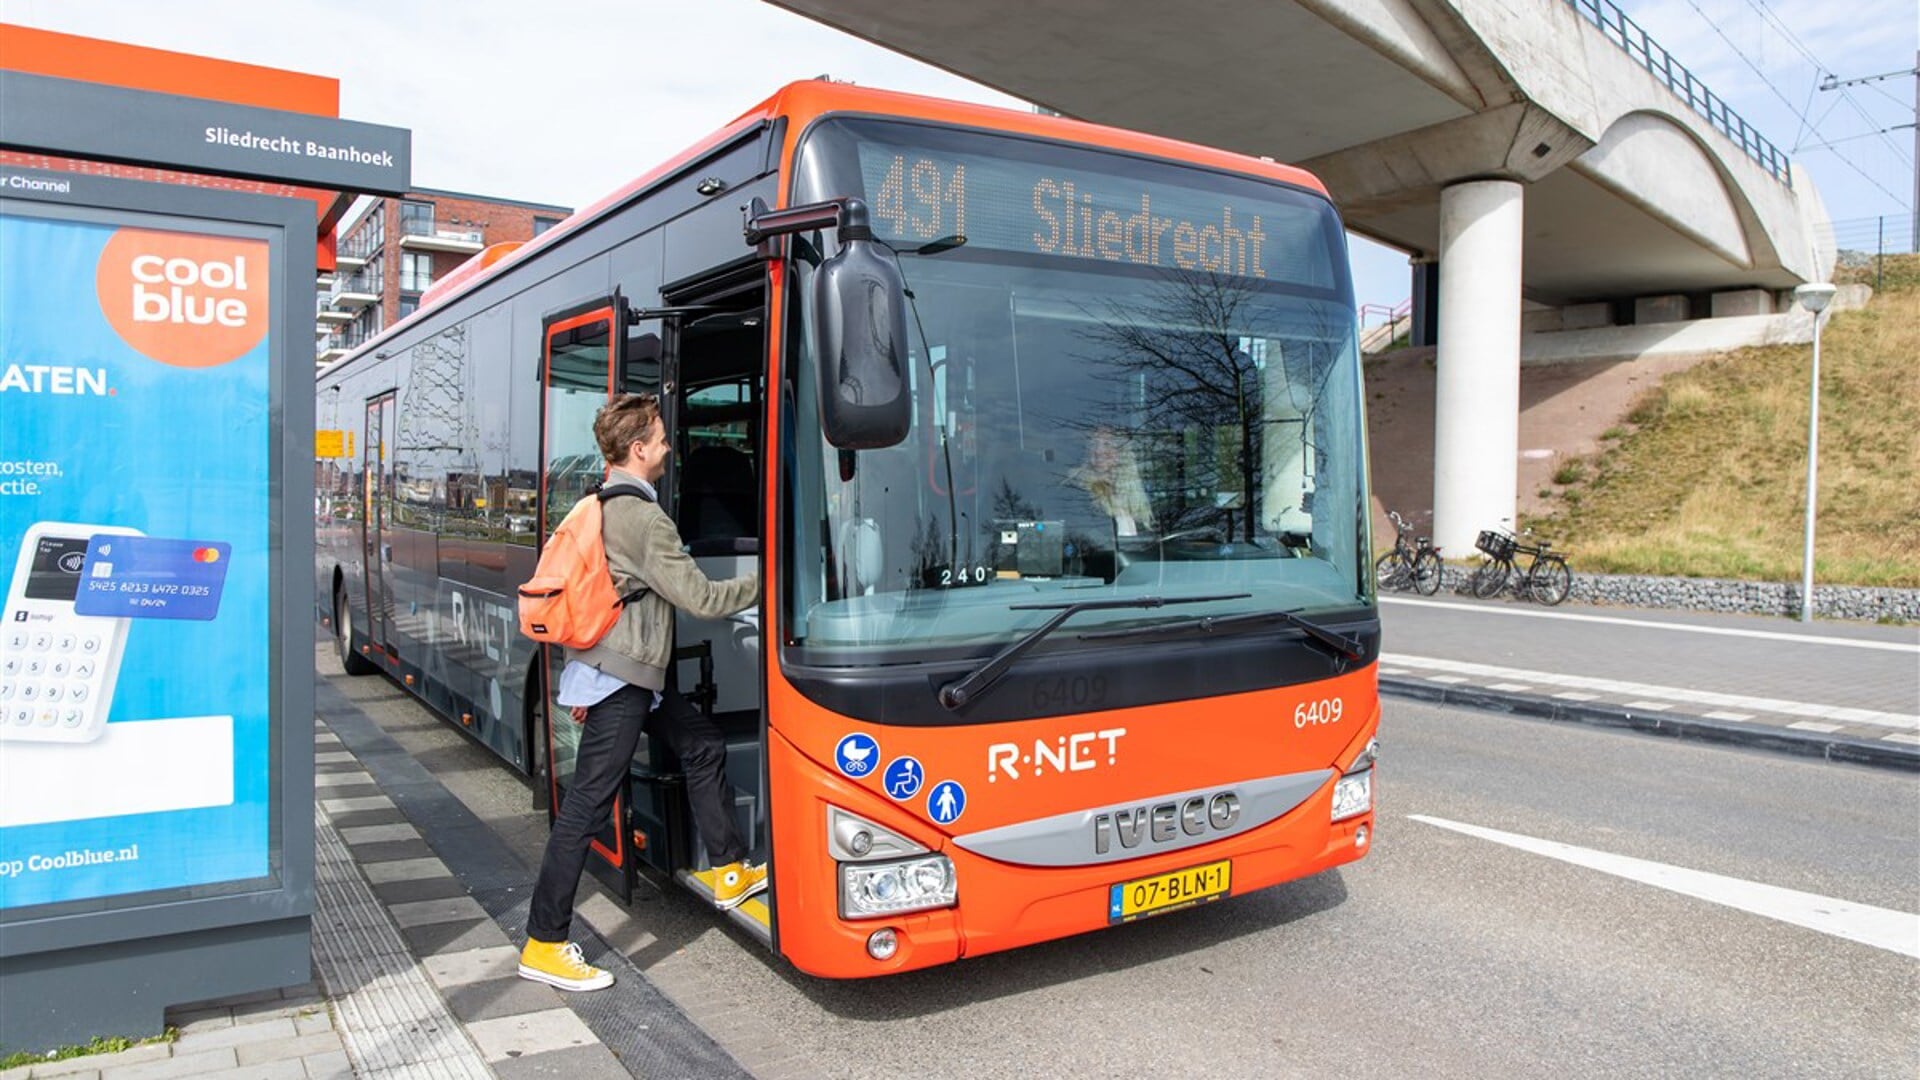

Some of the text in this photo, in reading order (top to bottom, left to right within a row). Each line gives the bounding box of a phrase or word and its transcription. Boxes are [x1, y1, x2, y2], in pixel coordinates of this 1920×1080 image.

[204, 127, 394, 168] Sliedrecht Baanhoek
[10, 175, 70, 193] Channel
[876, 155, 1267, 278] 491 Sliedrecht
[130, 254, 247, 290] cool
[132, 283, 247, 327] blue
[0, 363, 117, 397] ATEN.
[0, 460, 64, 478] osten,
[88, 581, 117, 592] 5425
[941, 565, 985, 586] 240
[1294, 697, 1343, 729] 6409
[1094, 790, 1241, 856] IVECO
[0, 844, 139, 878] op Coolblue.nl
[1133, 867, 1222, 908] 07-BLN-1
